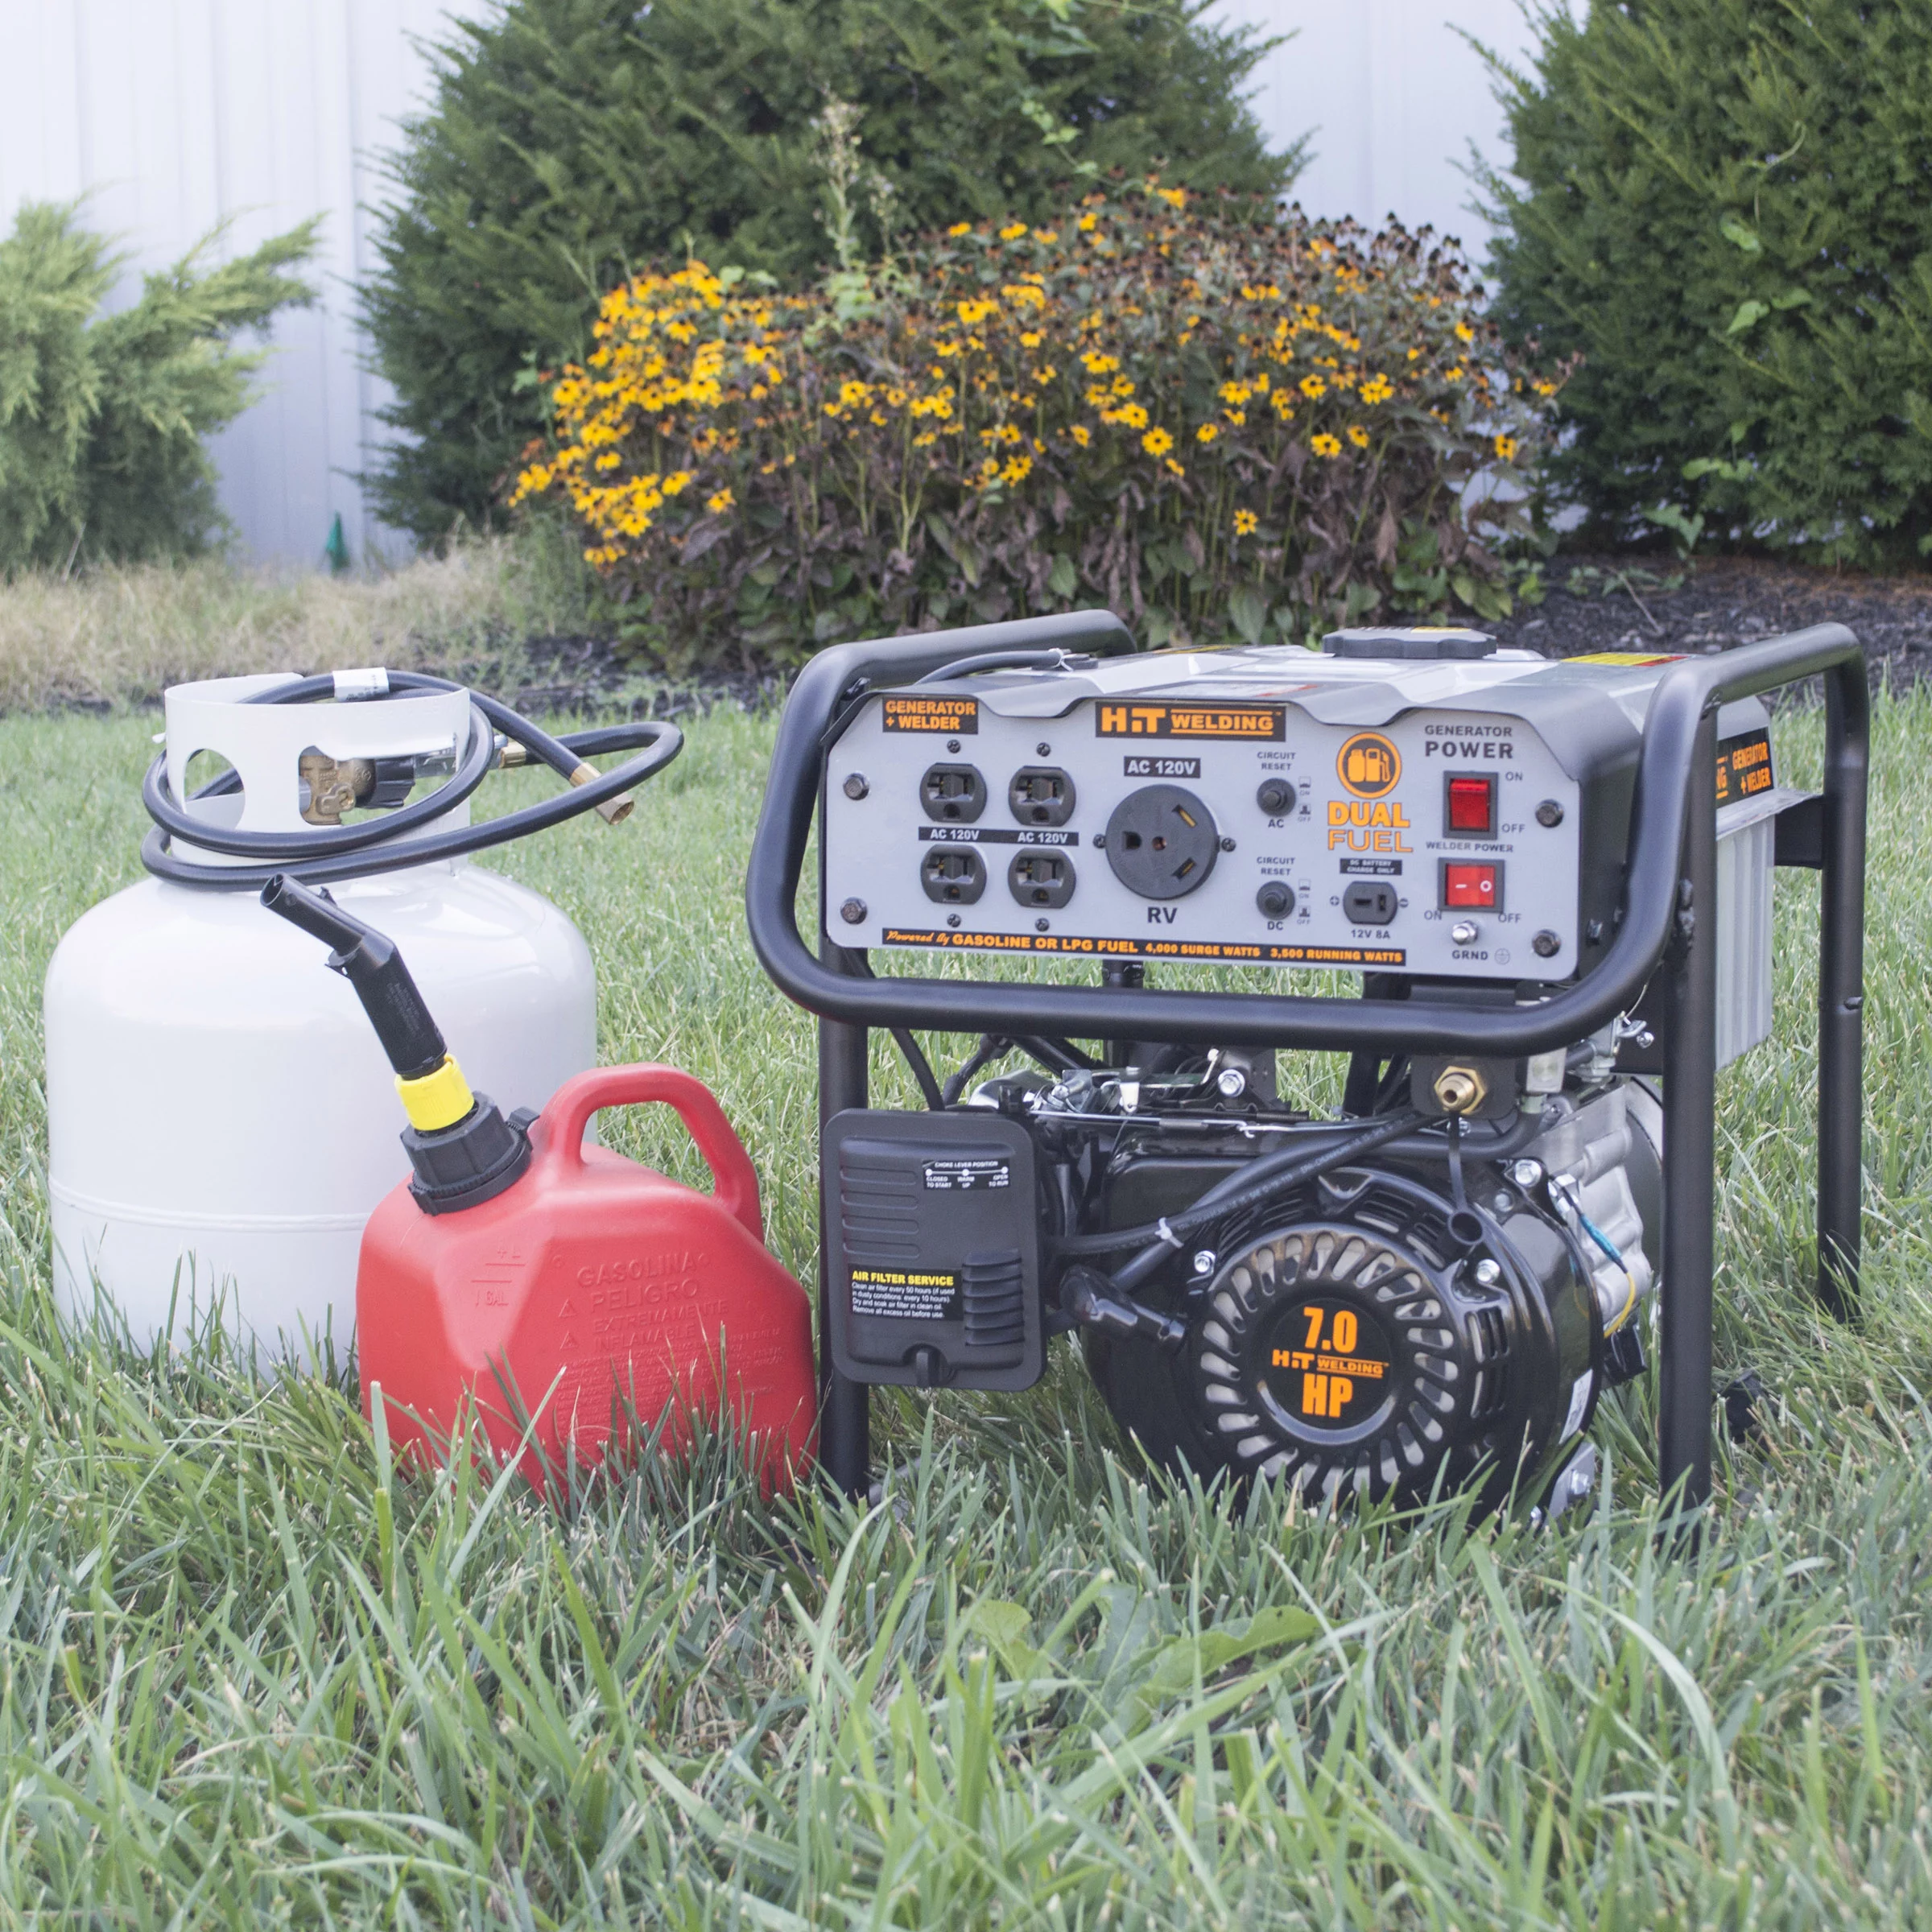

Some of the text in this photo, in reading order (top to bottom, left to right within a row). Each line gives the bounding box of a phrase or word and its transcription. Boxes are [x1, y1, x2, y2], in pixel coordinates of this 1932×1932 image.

[886, 700, 976, 715] GENERATOR
[898, 716, 960, 730] WELDER
[1171, 713, 1274, 731] WELDING
[1425, 725, 1513, 737] GENERATOR
[1425, 741, 1513, 759] POWER
[1127, 759, 1195, 775] AC 120V
[1505, 772, 1523, 782] ON
[1327, 800, 1410, 828] DUAL
[1268, 819, 1284, 828] AC
[1501, 823, 1525, 833] OFF
[930, 829, 980, 840] AC 120V
[1018, 832, 1068, 844] AC 120V
[1327, 829, 1414, 852] FUEL
[1426, 841, 1513, 852] WELDER POWER
[1257, 857, 1295, 865] CIRCUIT
[1147, 906, 1178, 923] RV
[1424, 910, 1443, 920] ON
[1498, 913, 1521, 923] OFF
[1267, 921, 1284, 931] DC
[1351, 930, 1390, 939] 12V 8A
[886, 931, 1402, 962] Powered By GASOLINE OR LPG FUEL 4,000 SURGE WATTS 3,500 RUNNING WATTS
[1452, 950, 1488, 960] GRND
[577, 1252, 697, 1287] GASOLINA
[852, 1270, 954, 1286] AIR FILTER SERVICE
[589, 1278, 700, 1313] PELIGRO
[1303, 1307, 1357, 1353] 7.0
[1317, 1356, 1383, 1375] WELDING
[1302, 1373, 1353, 1418] HP
